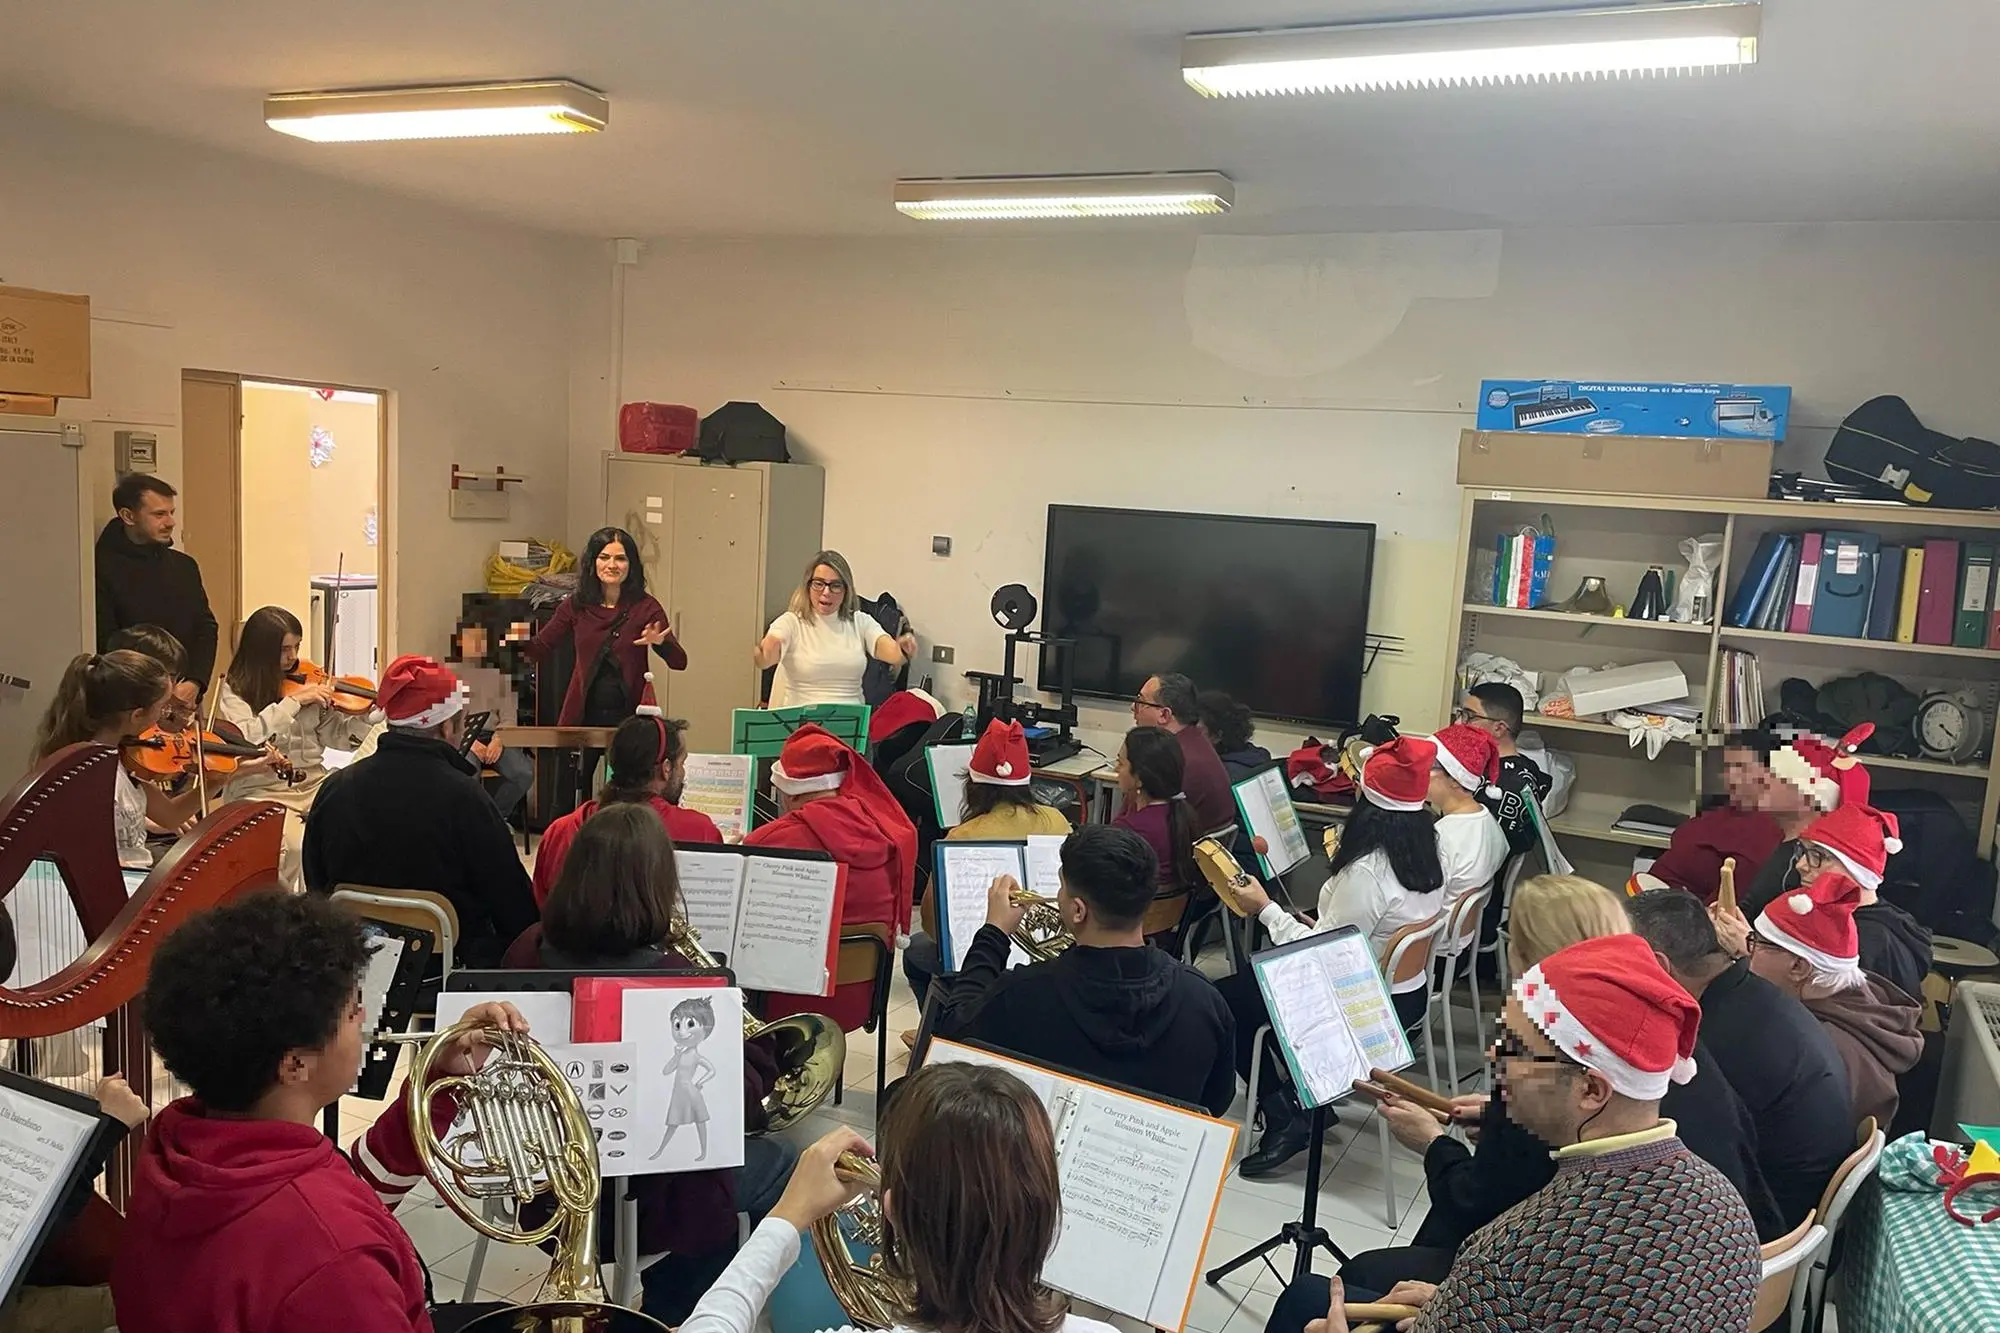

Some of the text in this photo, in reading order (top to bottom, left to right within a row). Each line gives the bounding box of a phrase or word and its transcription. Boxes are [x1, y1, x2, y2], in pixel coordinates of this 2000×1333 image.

[1607, 385, 1648, 393] KEYBOARD
[10, 1111, 42, 1132] bambino
[1103, 1105, 1127, 1120] Cherry
[1128, 1113, 1145, 1126] Pink
[1146, 1120, 1160, 1131] and
[1160, 1124, 1181, 1138] Apple
[1114, 1119, 1166, 1144] Blossom White
